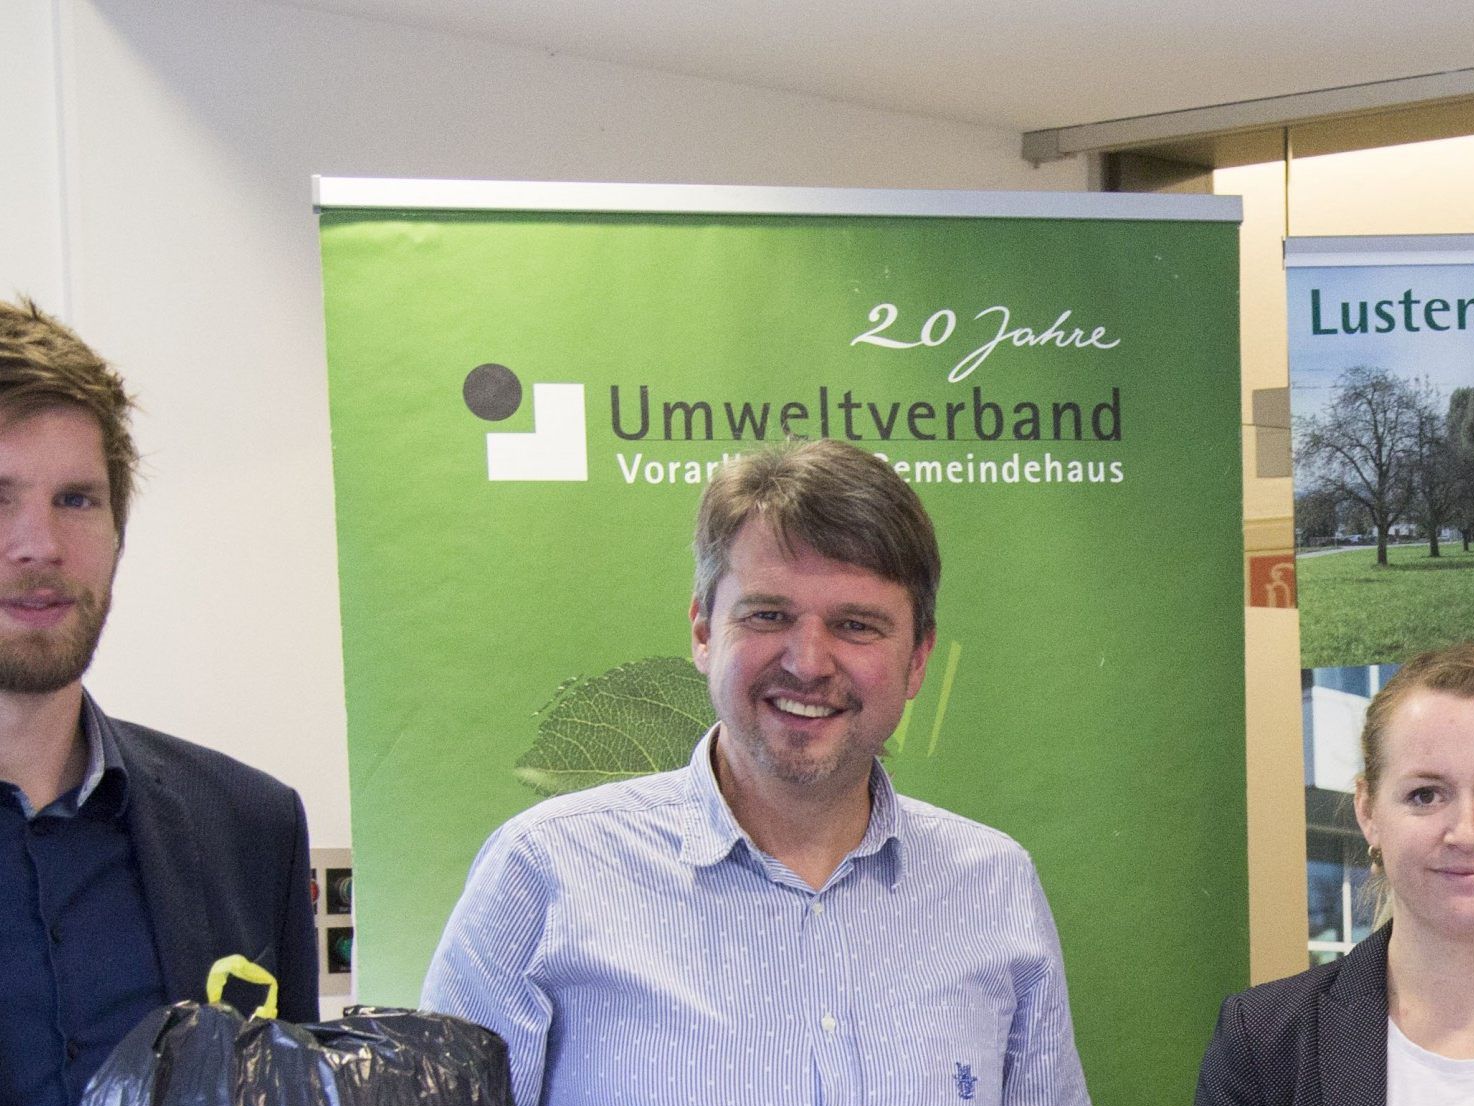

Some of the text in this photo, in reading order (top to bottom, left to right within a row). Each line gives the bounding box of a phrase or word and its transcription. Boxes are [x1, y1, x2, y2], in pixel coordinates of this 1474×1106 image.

[851, 303, 1121, 383] 20 Jahre
[611, 385, 1121, 441] Umweltverband
[873, 453, 1124, 483] emeindehaus
